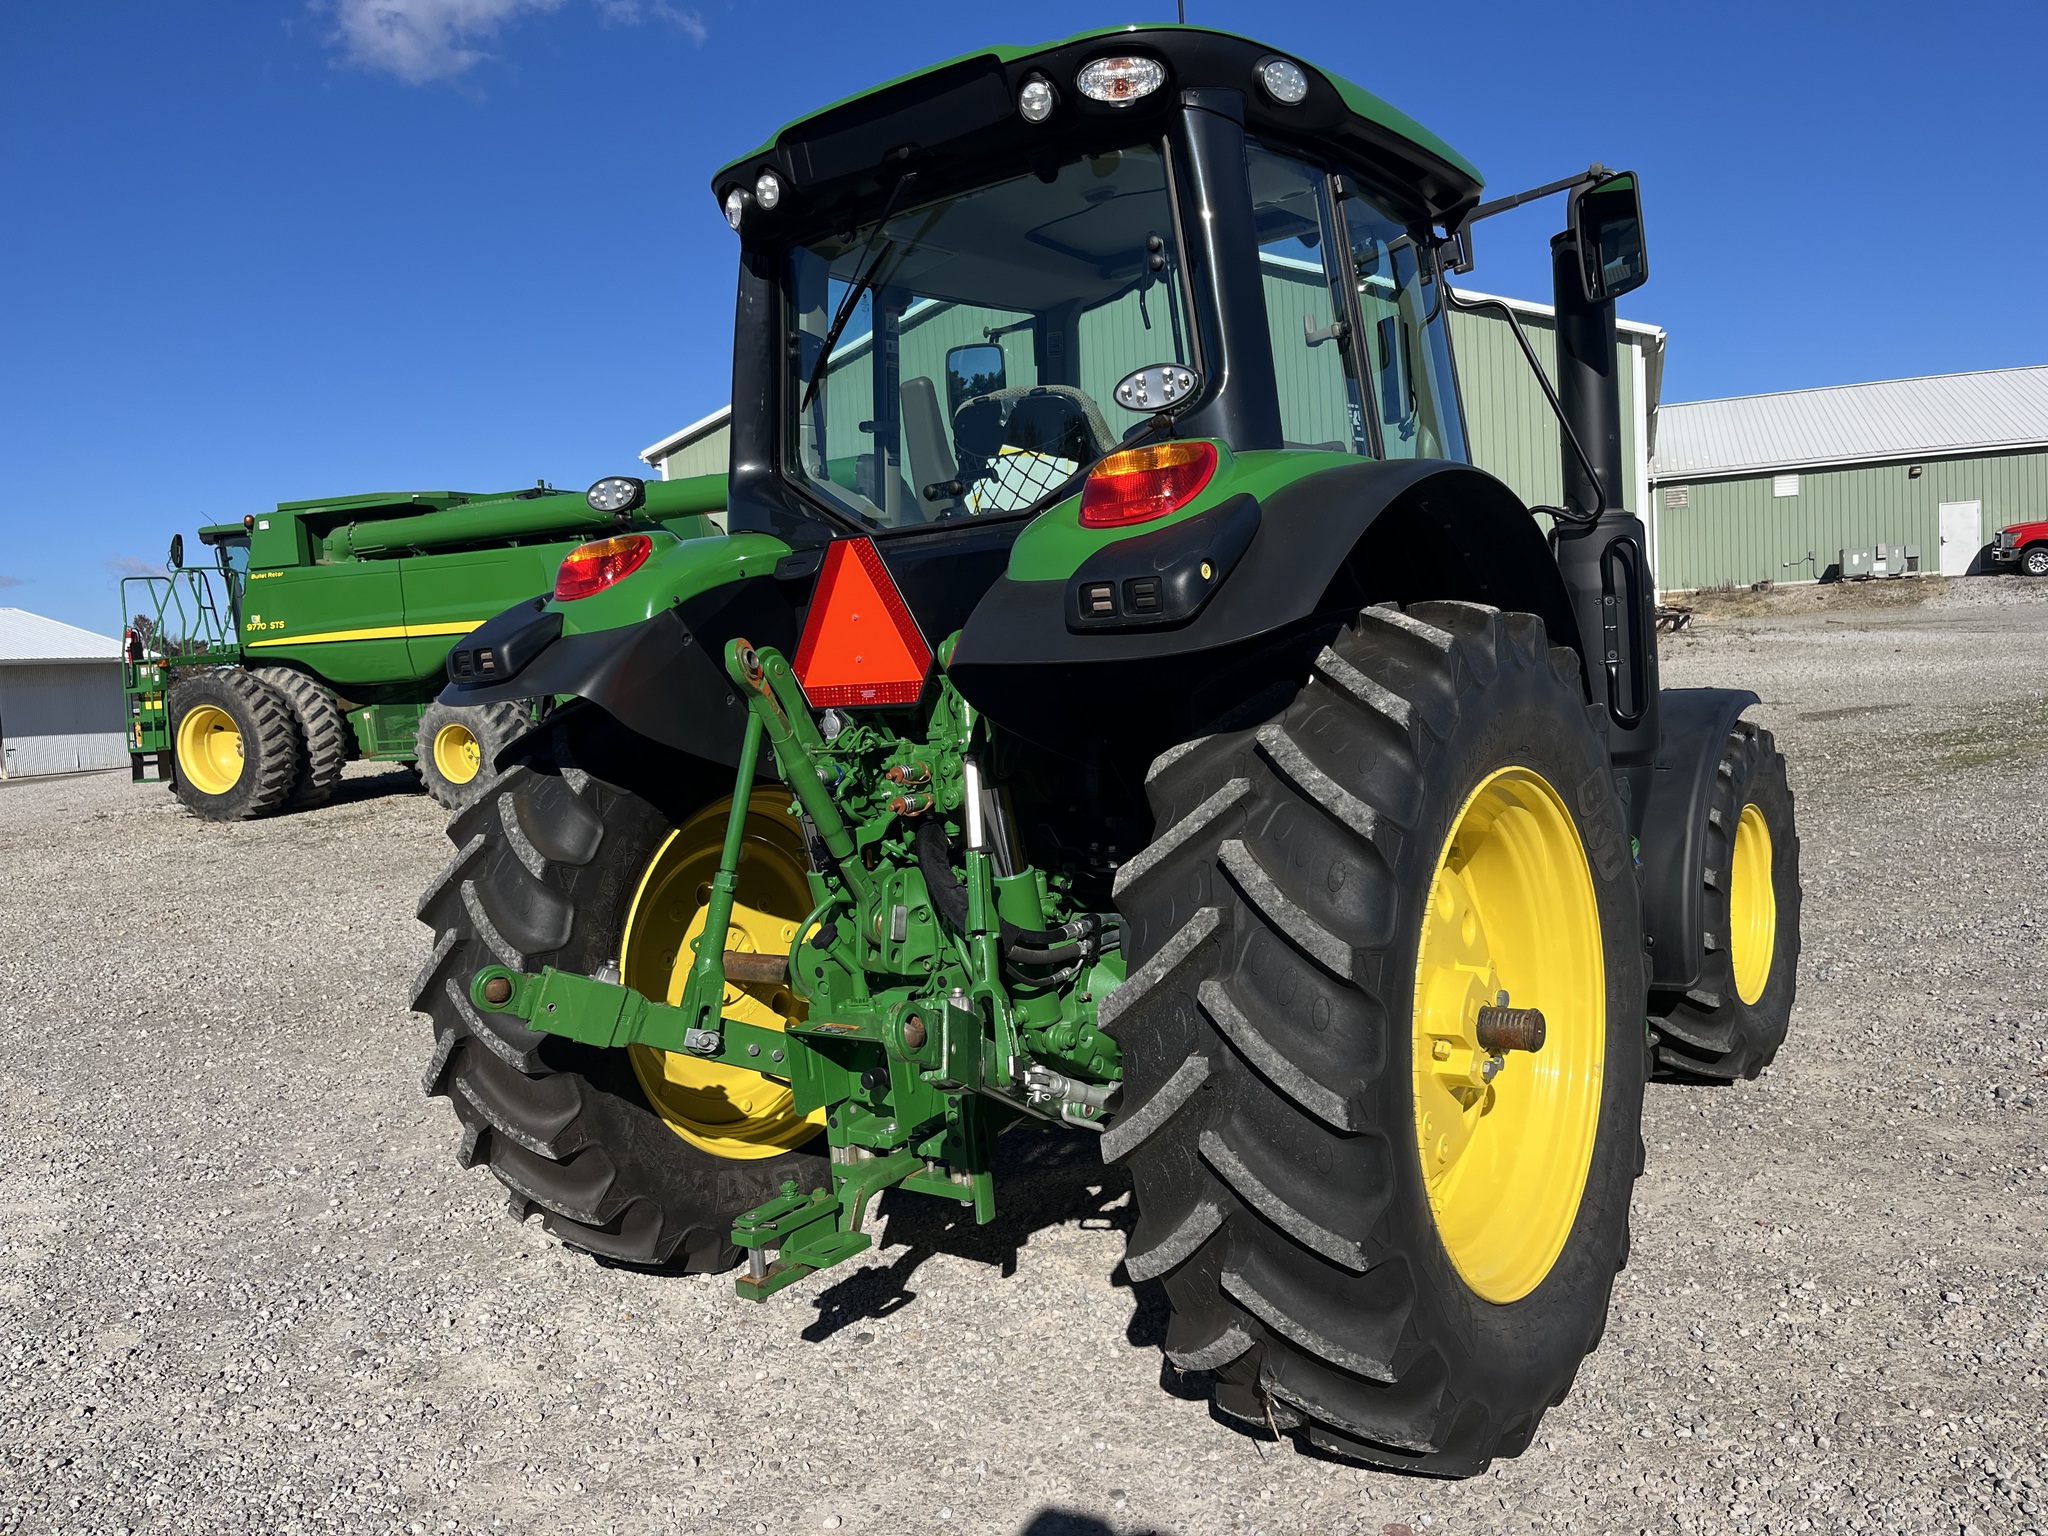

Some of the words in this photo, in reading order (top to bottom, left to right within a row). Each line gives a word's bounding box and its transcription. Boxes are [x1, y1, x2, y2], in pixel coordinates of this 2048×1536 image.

[246, 622, 267, 631] 9770
[269, 620, 285, 630] STS
[1577, 766, 1627, 882] BKT
